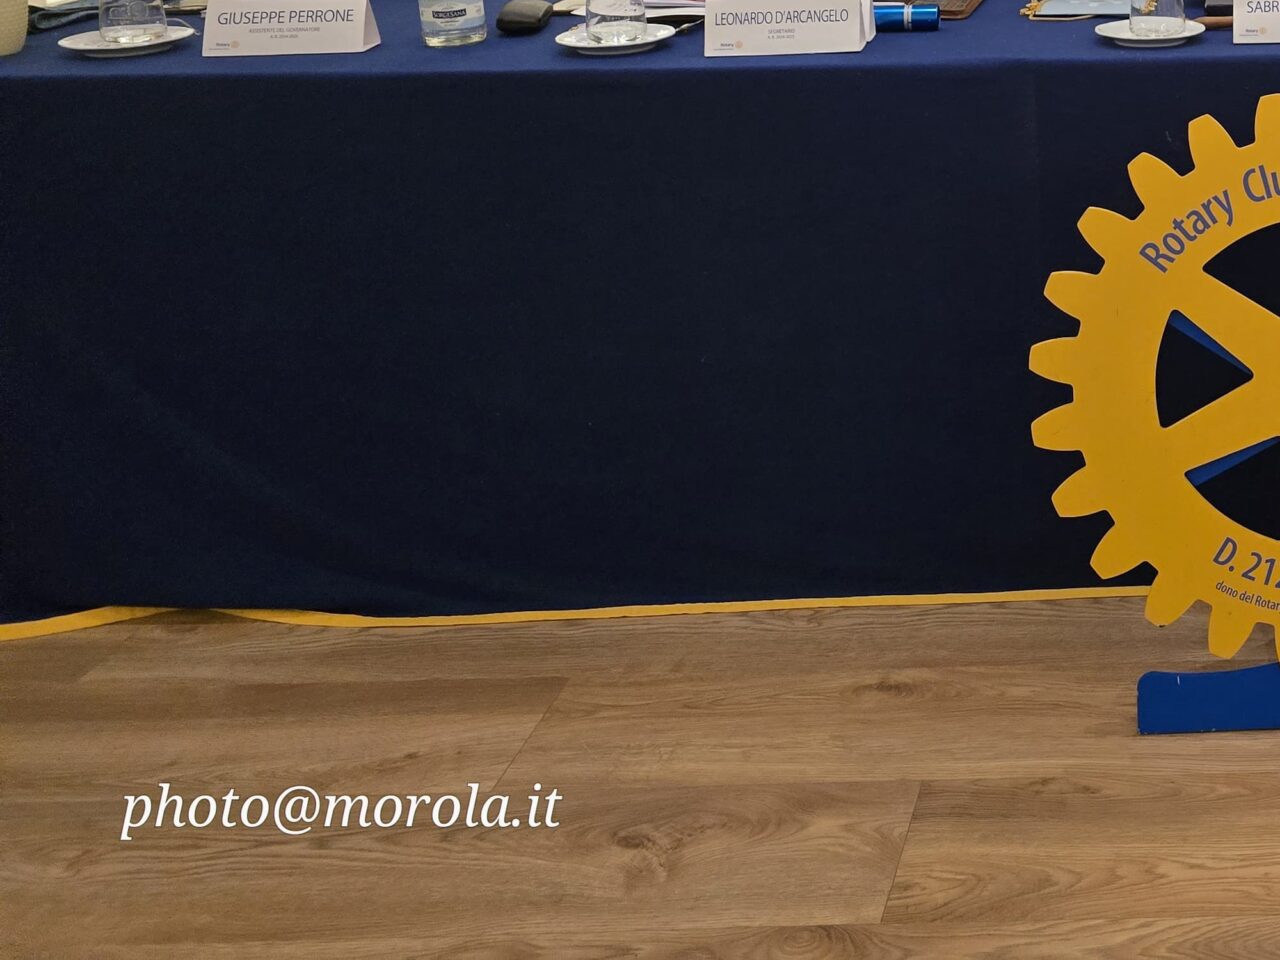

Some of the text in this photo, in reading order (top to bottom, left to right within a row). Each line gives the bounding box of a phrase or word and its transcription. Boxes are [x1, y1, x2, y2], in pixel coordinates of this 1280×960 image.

[217, 9, 354, 25] GIUSEPPE PERRONE
[714, 8, 849, 26] LEONARDO D'ARCANGELO
[1139, 189, 1234, 273] Rotary
[1212, 536, 1238, 572] D.
[1215, 580, 1238, 599] dono
[1239, 589, 1254, 604] del
